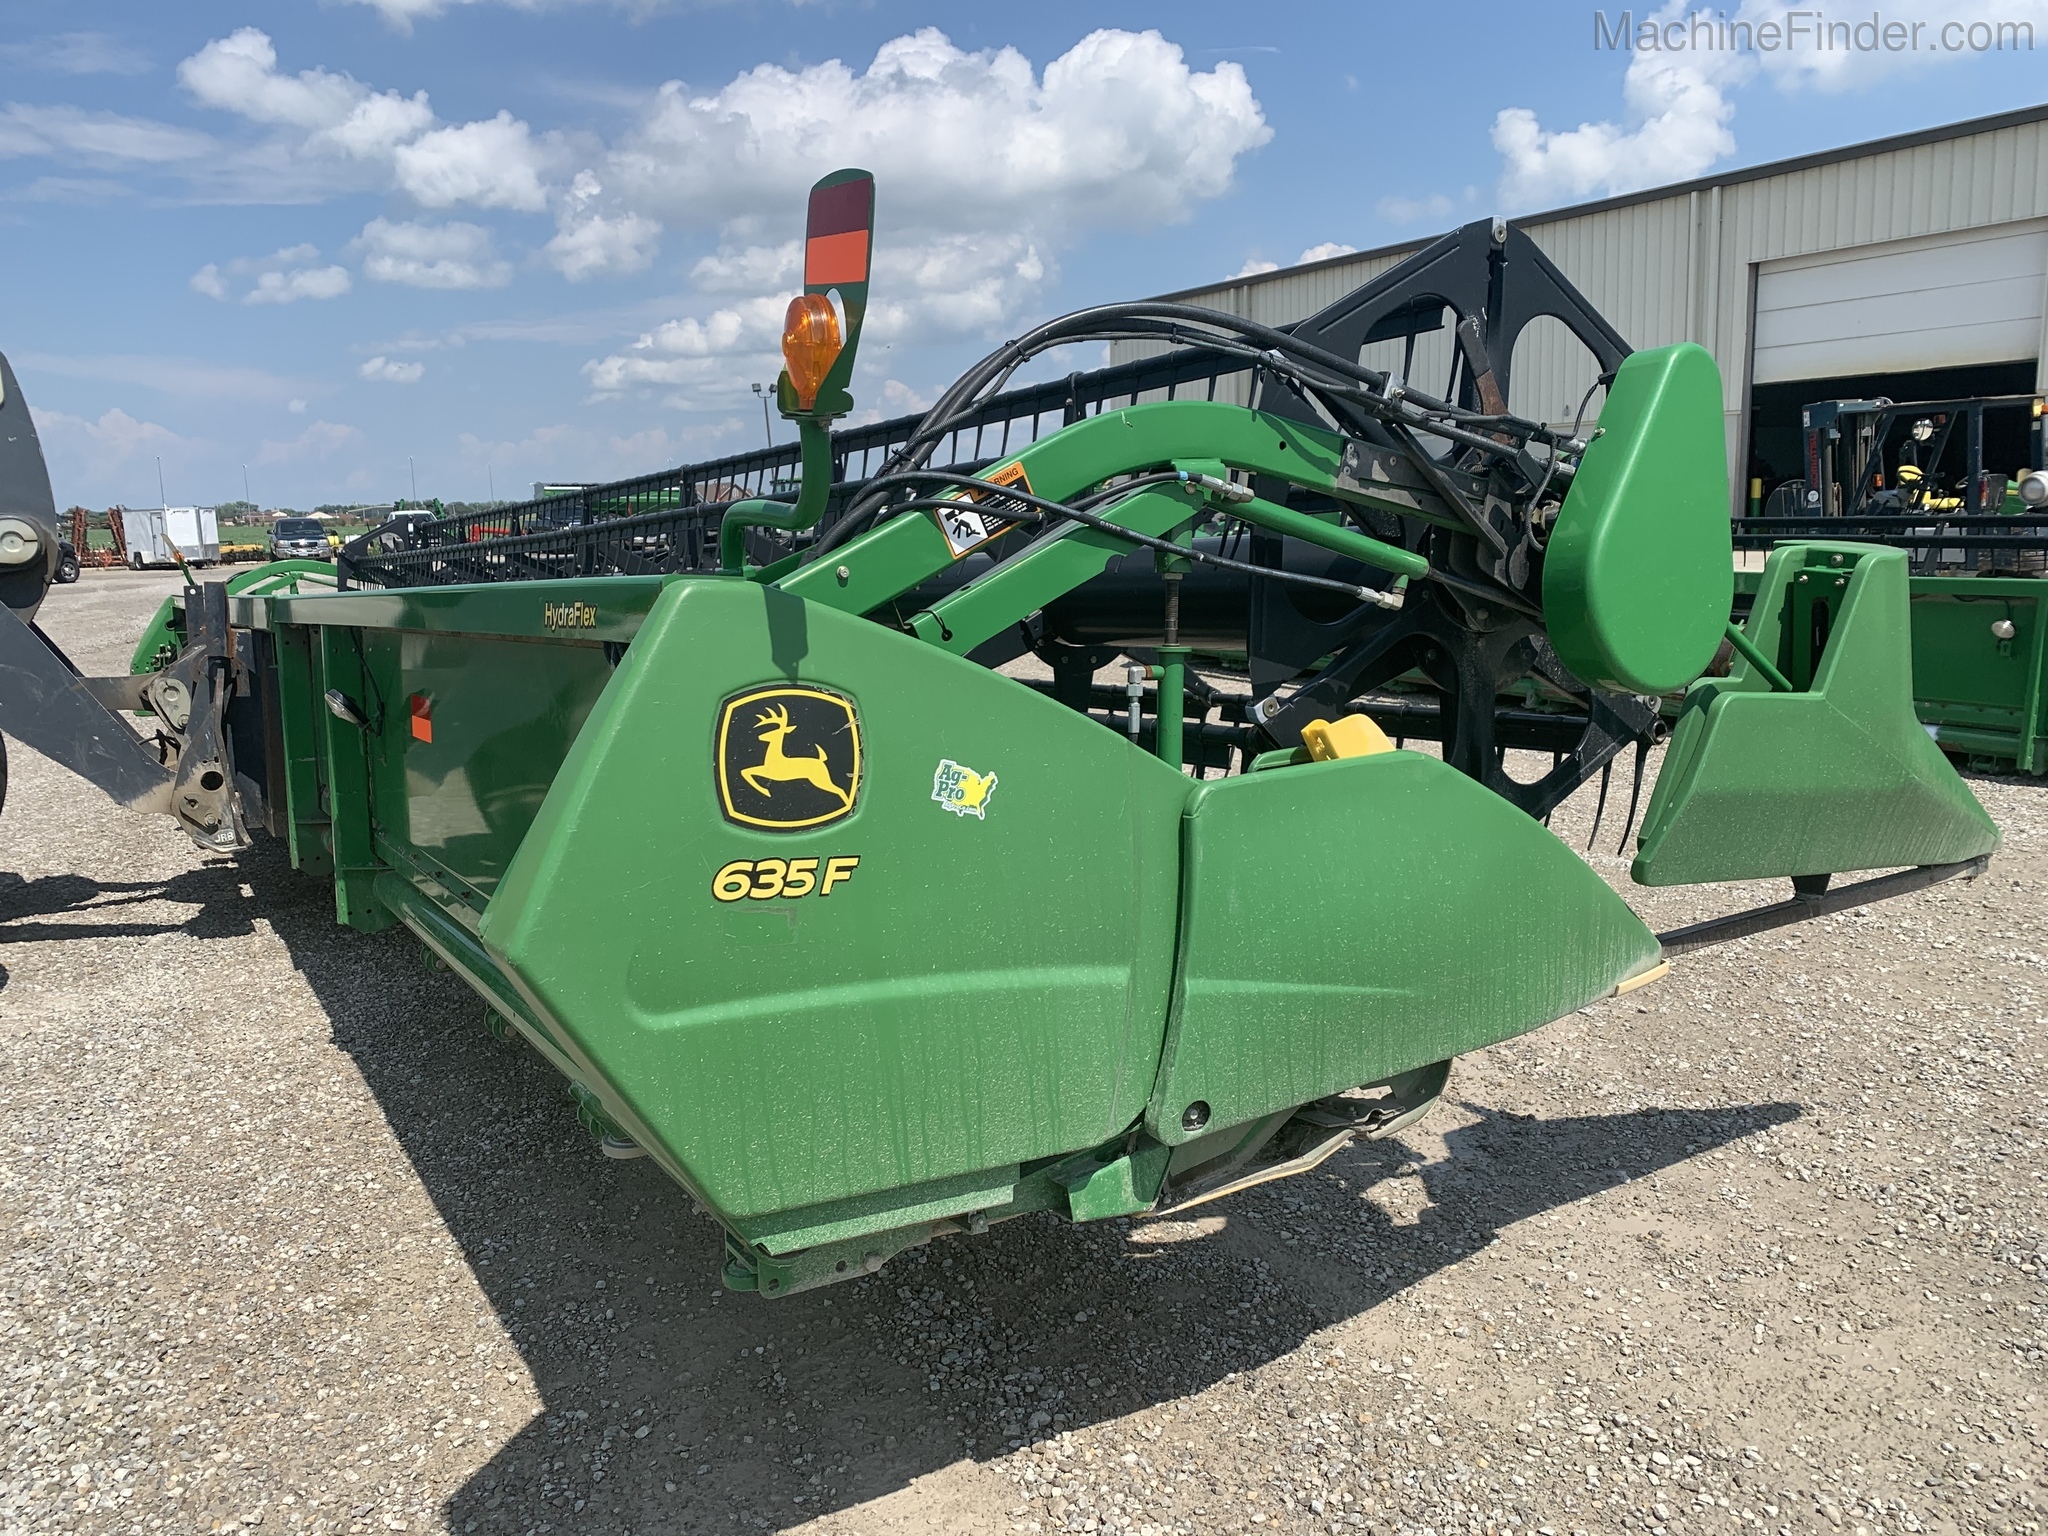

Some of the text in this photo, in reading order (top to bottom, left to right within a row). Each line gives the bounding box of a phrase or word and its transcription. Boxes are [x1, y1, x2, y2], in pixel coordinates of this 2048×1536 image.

[544, 601, 597, 632] HydraFlex
[939, 764, 968, 786] Ag-
[936, 781, 965, 800] Pro
[215, 832, 234, 844] JRB
